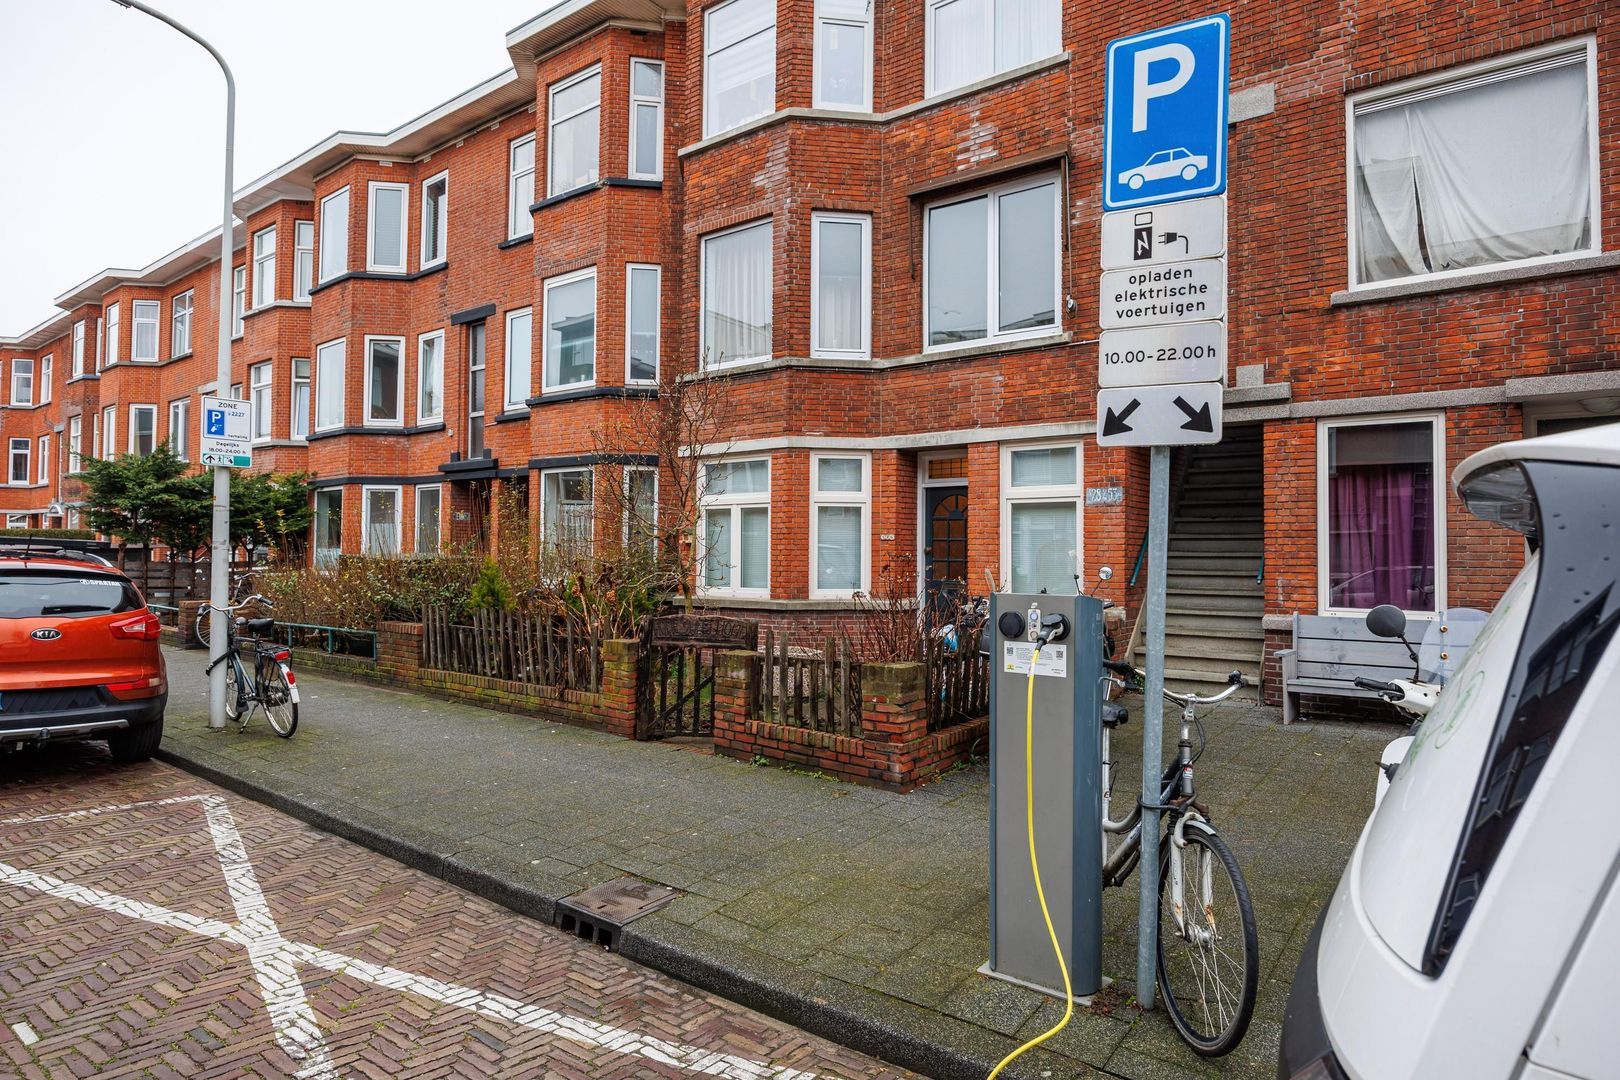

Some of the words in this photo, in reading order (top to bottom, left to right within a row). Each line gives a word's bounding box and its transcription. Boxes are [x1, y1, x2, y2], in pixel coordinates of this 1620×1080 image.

[1133, 43, 1196, 133] P
[1129, 269, 1192, 285] opladen
[1115, 283, 1207, 303] elektrische
[1117, 302, 1204, 319] voertuigen
[212, 411, 221, 423] P
[36, 630, 56, 638] KIA
